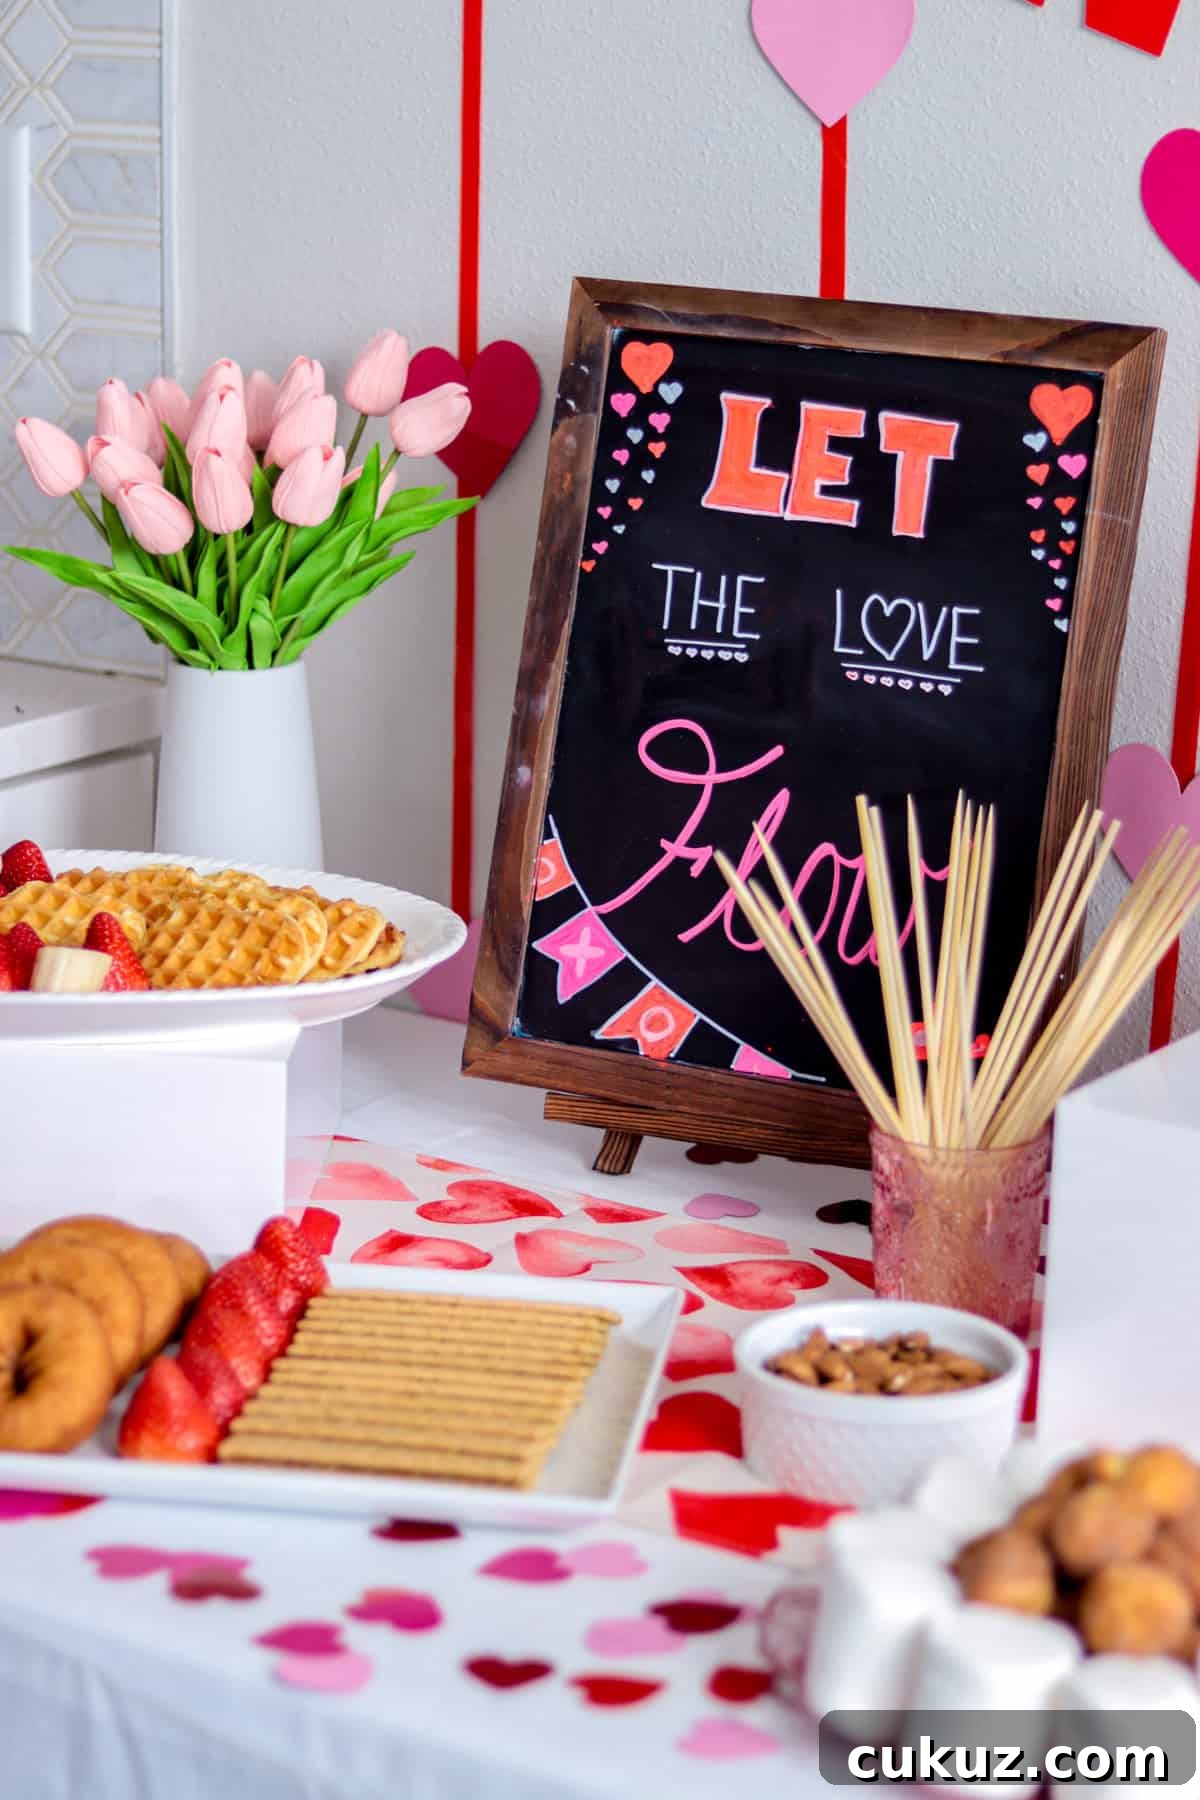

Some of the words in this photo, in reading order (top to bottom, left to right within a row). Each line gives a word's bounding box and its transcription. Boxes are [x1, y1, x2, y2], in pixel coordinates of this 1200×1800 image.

[702, 392, 959, 538] LET
[651, 563, 766, 640] THE
[833, 588, 985, 673] LOVE
